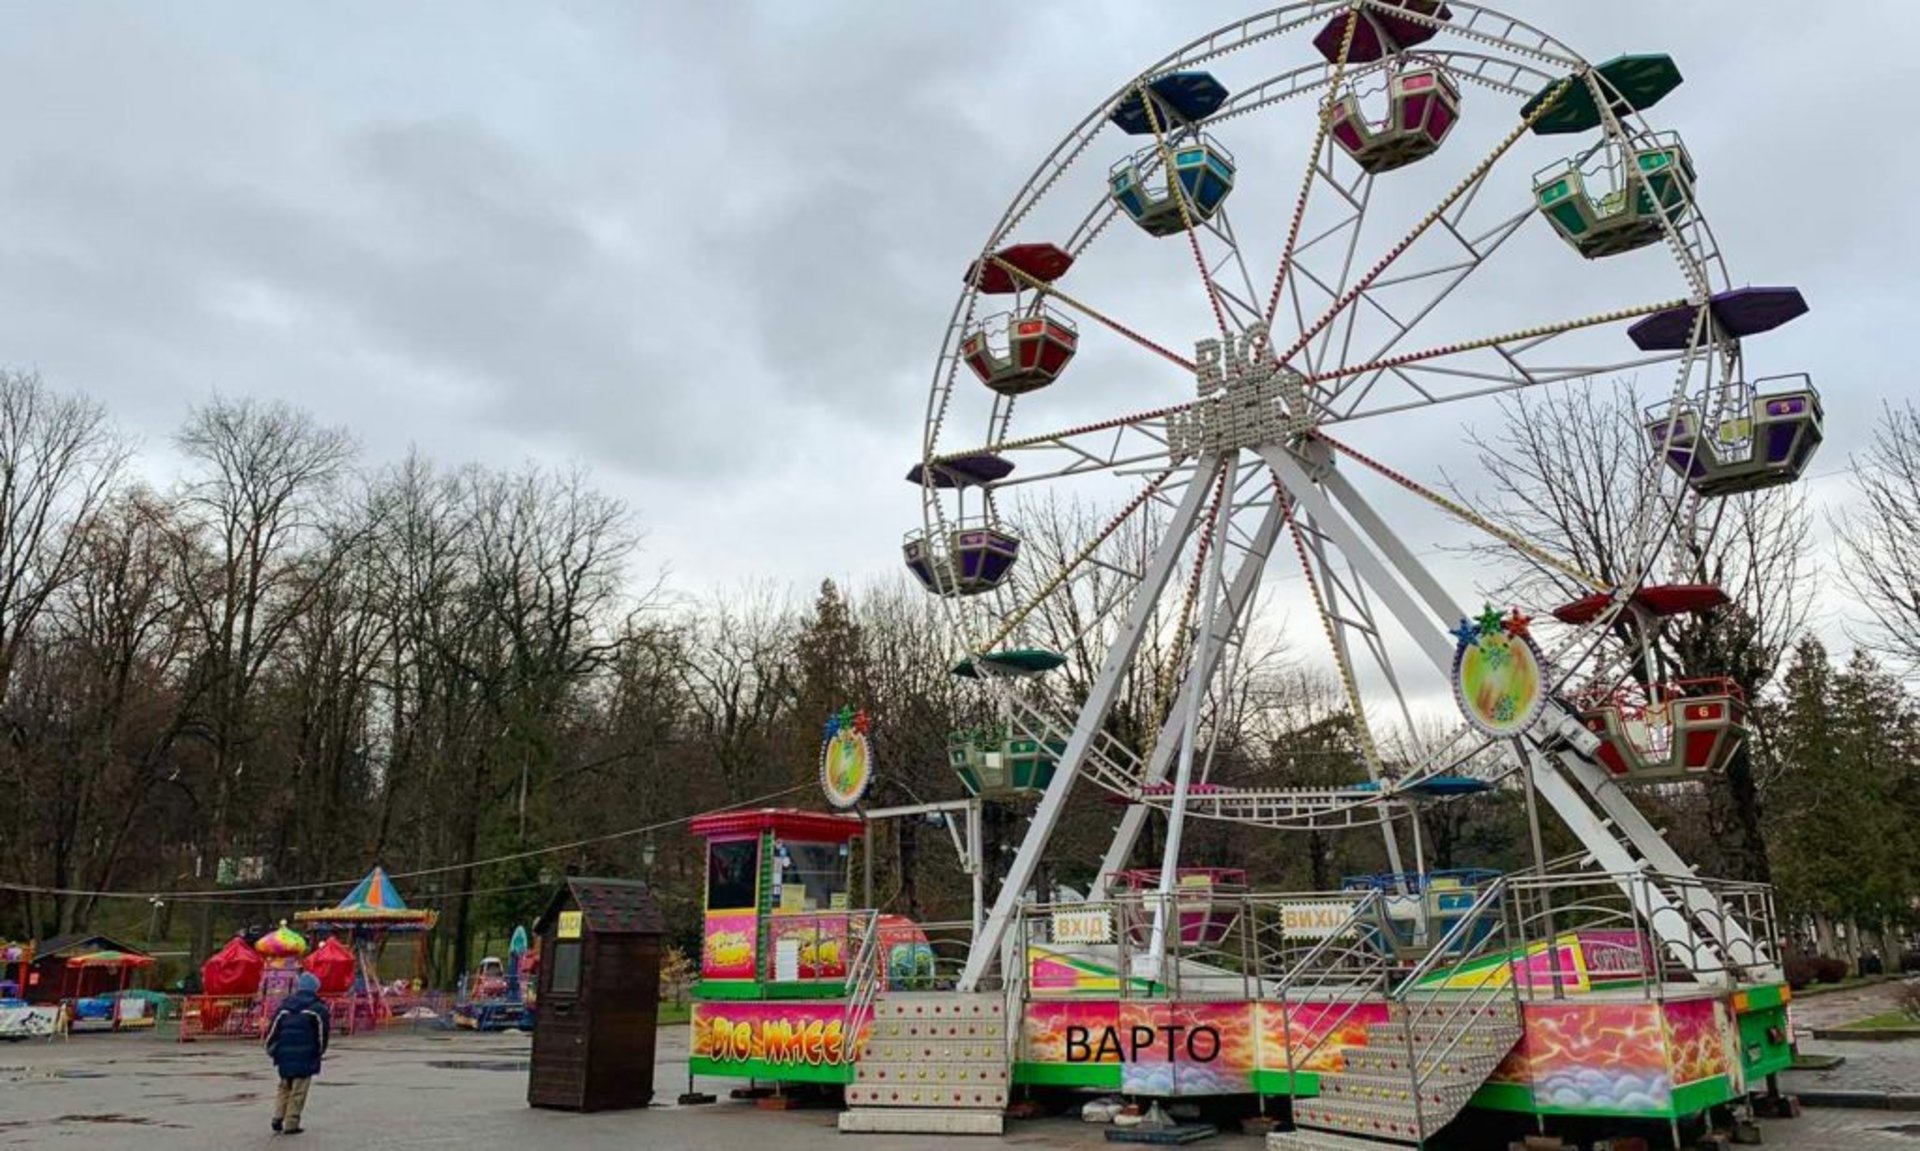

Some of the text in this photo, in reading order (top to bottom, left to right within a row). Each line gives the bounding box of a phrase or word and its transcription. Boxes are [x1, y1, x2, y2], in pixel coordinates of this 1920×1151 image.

[1195, 322, 1277, 397] BIG
[1699, 706, 1709, 717] 6
[1451, 897, 1459, 907] 7
[1059, 917, 1104, 938] ВХІД
[710, 1016, 751, 1063] BIG
